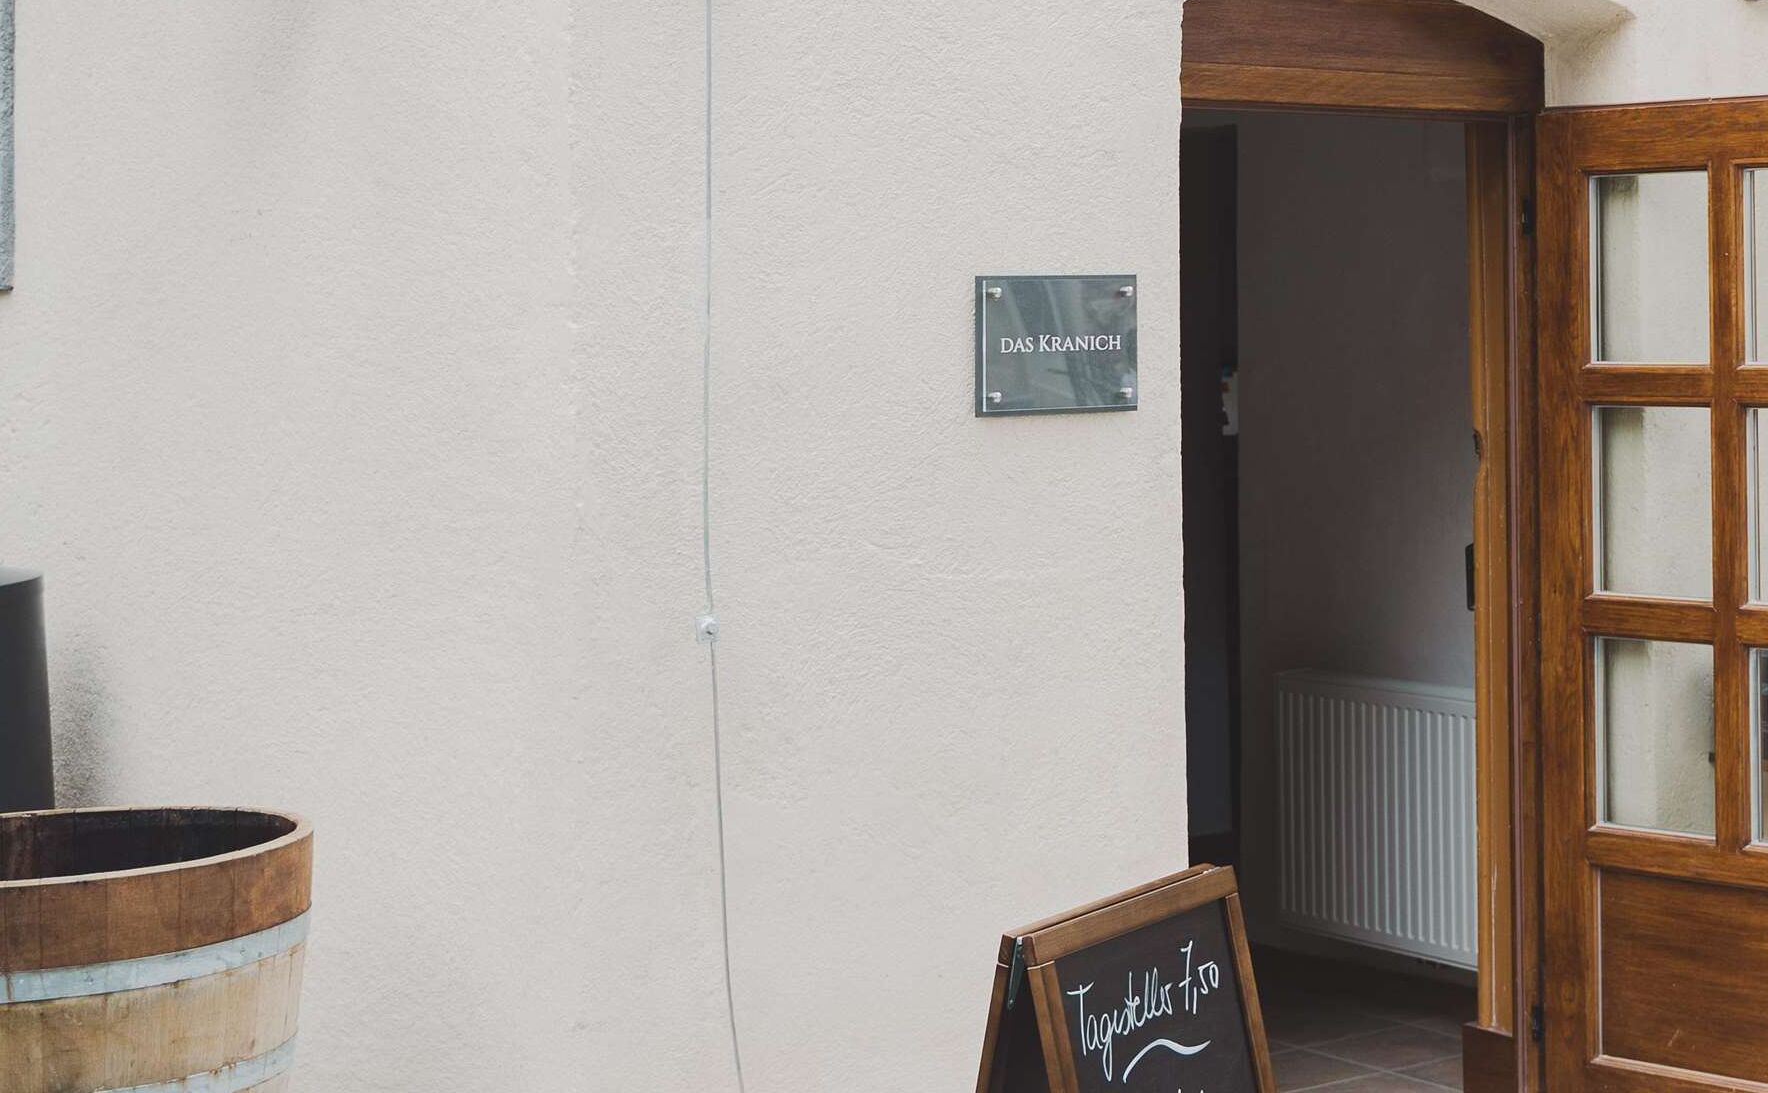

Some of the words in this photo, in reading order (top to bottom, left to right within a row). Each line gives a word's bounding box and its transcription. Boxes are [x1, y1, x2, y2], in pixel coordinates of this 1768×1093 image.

[1000, 336, 1034, 353] DAS
[1039, 334, 1122, 353] KRANICH
[1066, 967, 1173, 1082] Tagesteller
[1179, 940, 1220, 1015] 7,50
